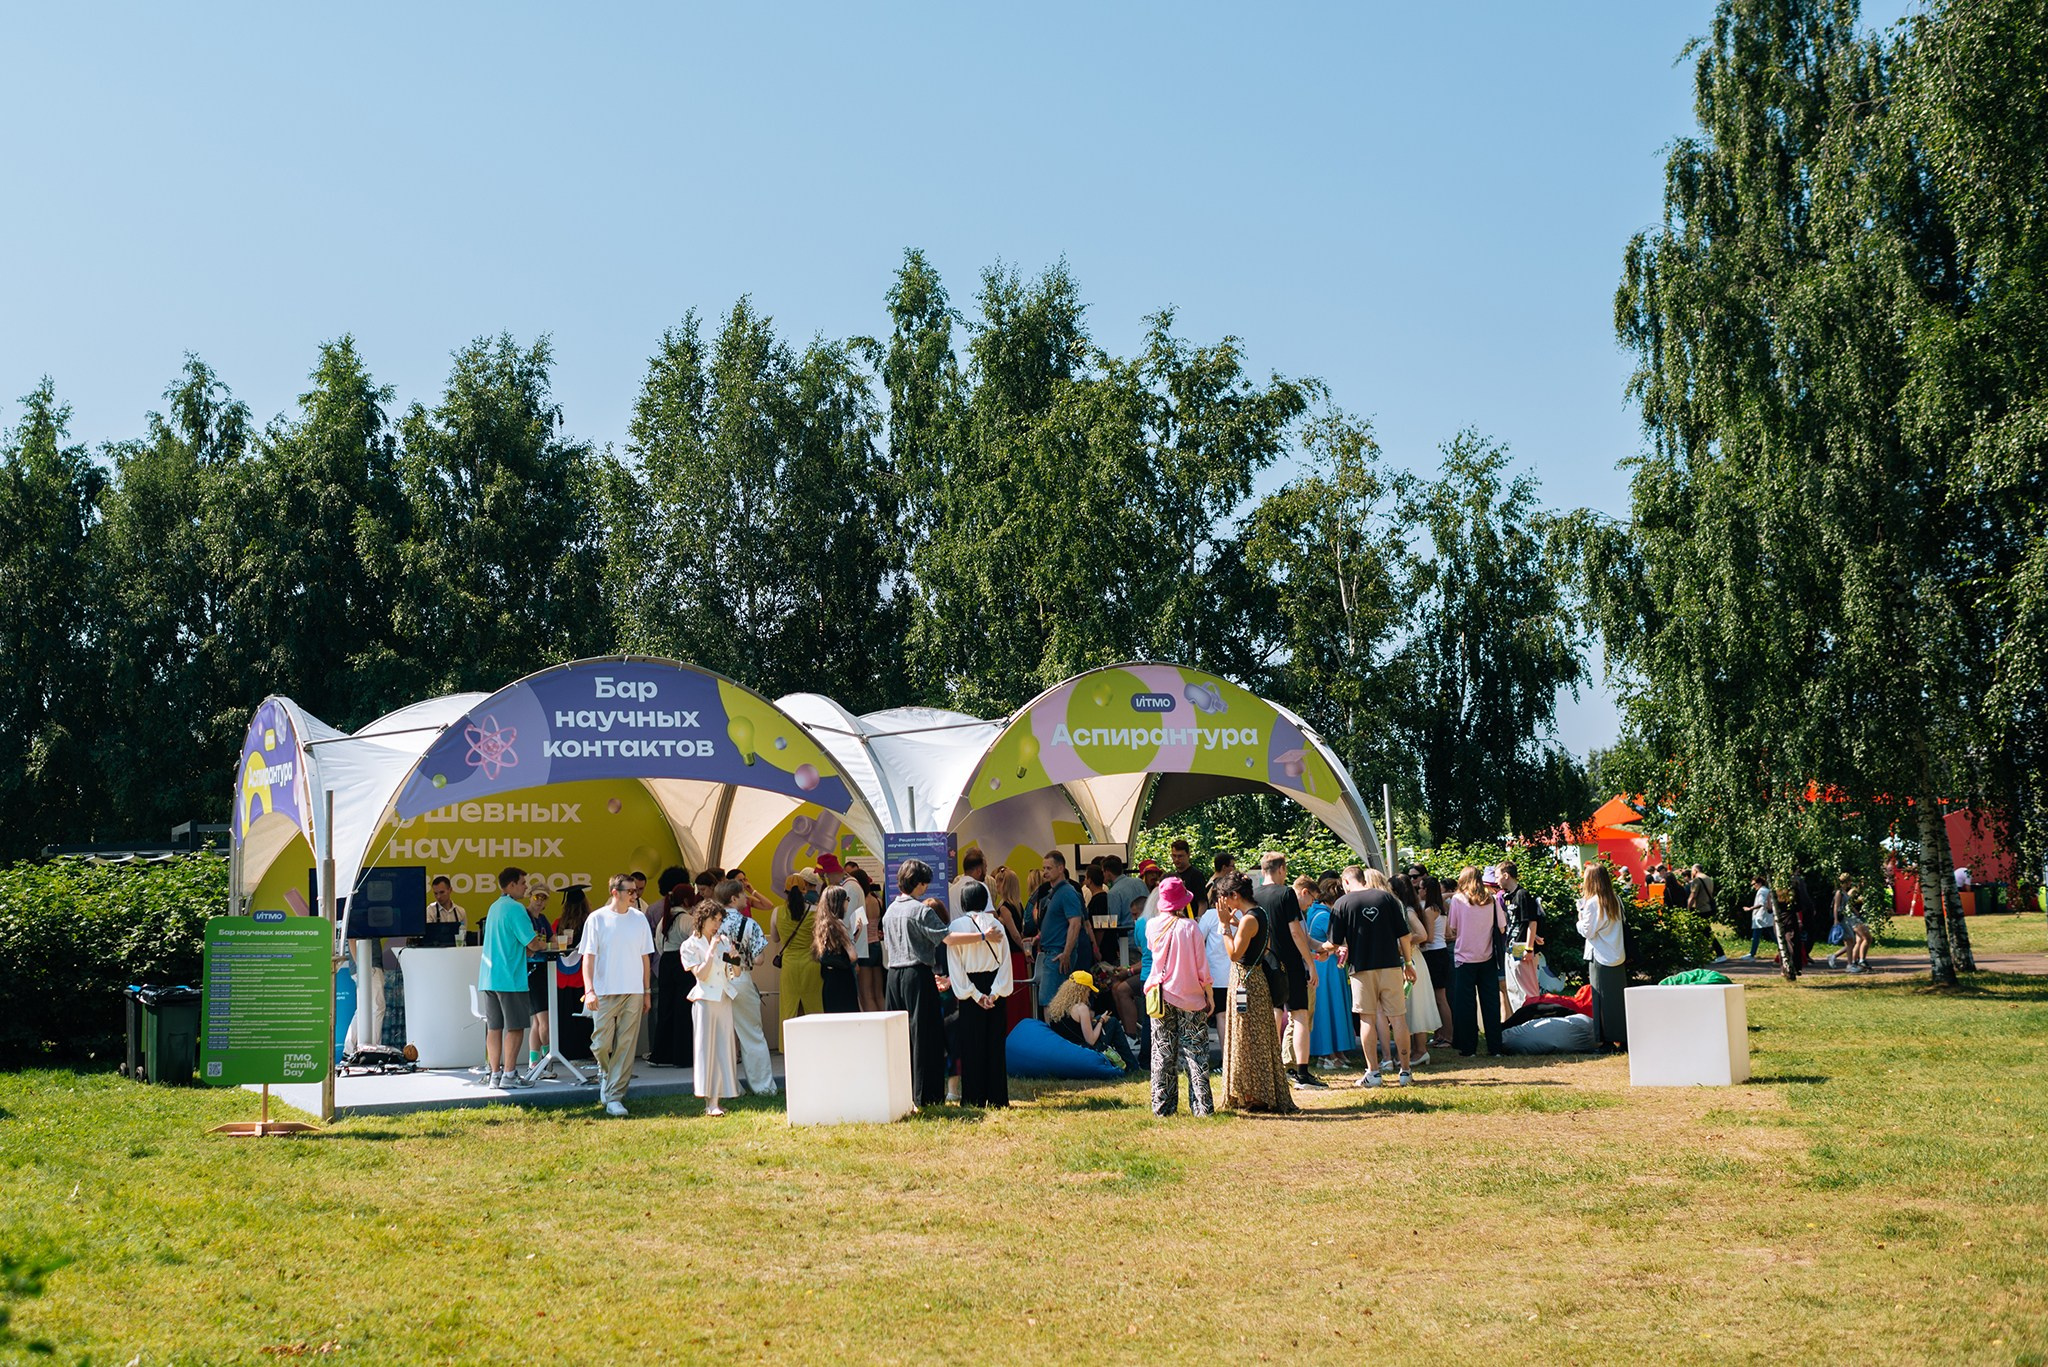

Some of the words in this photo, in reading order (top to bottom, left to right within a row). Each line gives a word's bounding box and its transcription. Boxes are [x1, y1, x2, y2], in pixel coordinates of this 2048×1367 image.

[594, 676, 658, 702] Бар
[555, 710, 701, 733] научных
[543, 739, 715, 758] контактов
[1050, 724, 1259, 750] Аспирантура
[248, 761, 293, 790] Аспирантура
[389, 837, 564, 864] научных
[283, 1053, 312, 1061] ITMO
[283, 1061, 318, 1070] Family
[283, 1069, 304, 1078] Day
